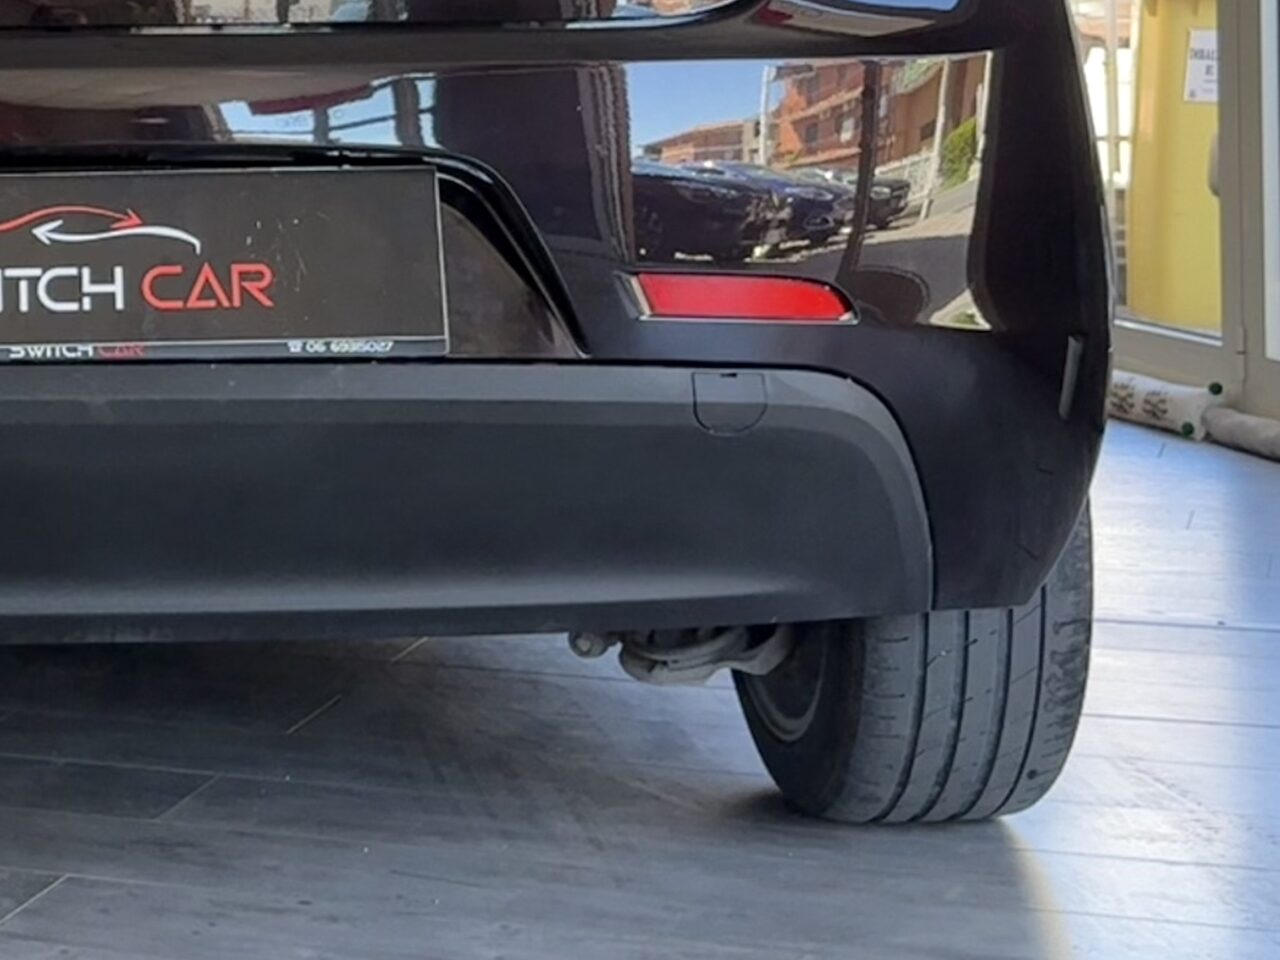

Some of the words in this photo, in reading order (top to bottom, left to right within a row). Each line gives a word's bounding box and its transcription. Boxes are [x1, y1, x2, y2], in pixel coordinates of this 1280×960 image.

[141, 261, 275, 310] CAR
[8, 343, 95, 359] SWITCH
[97, 341, 146, 358] CAR
